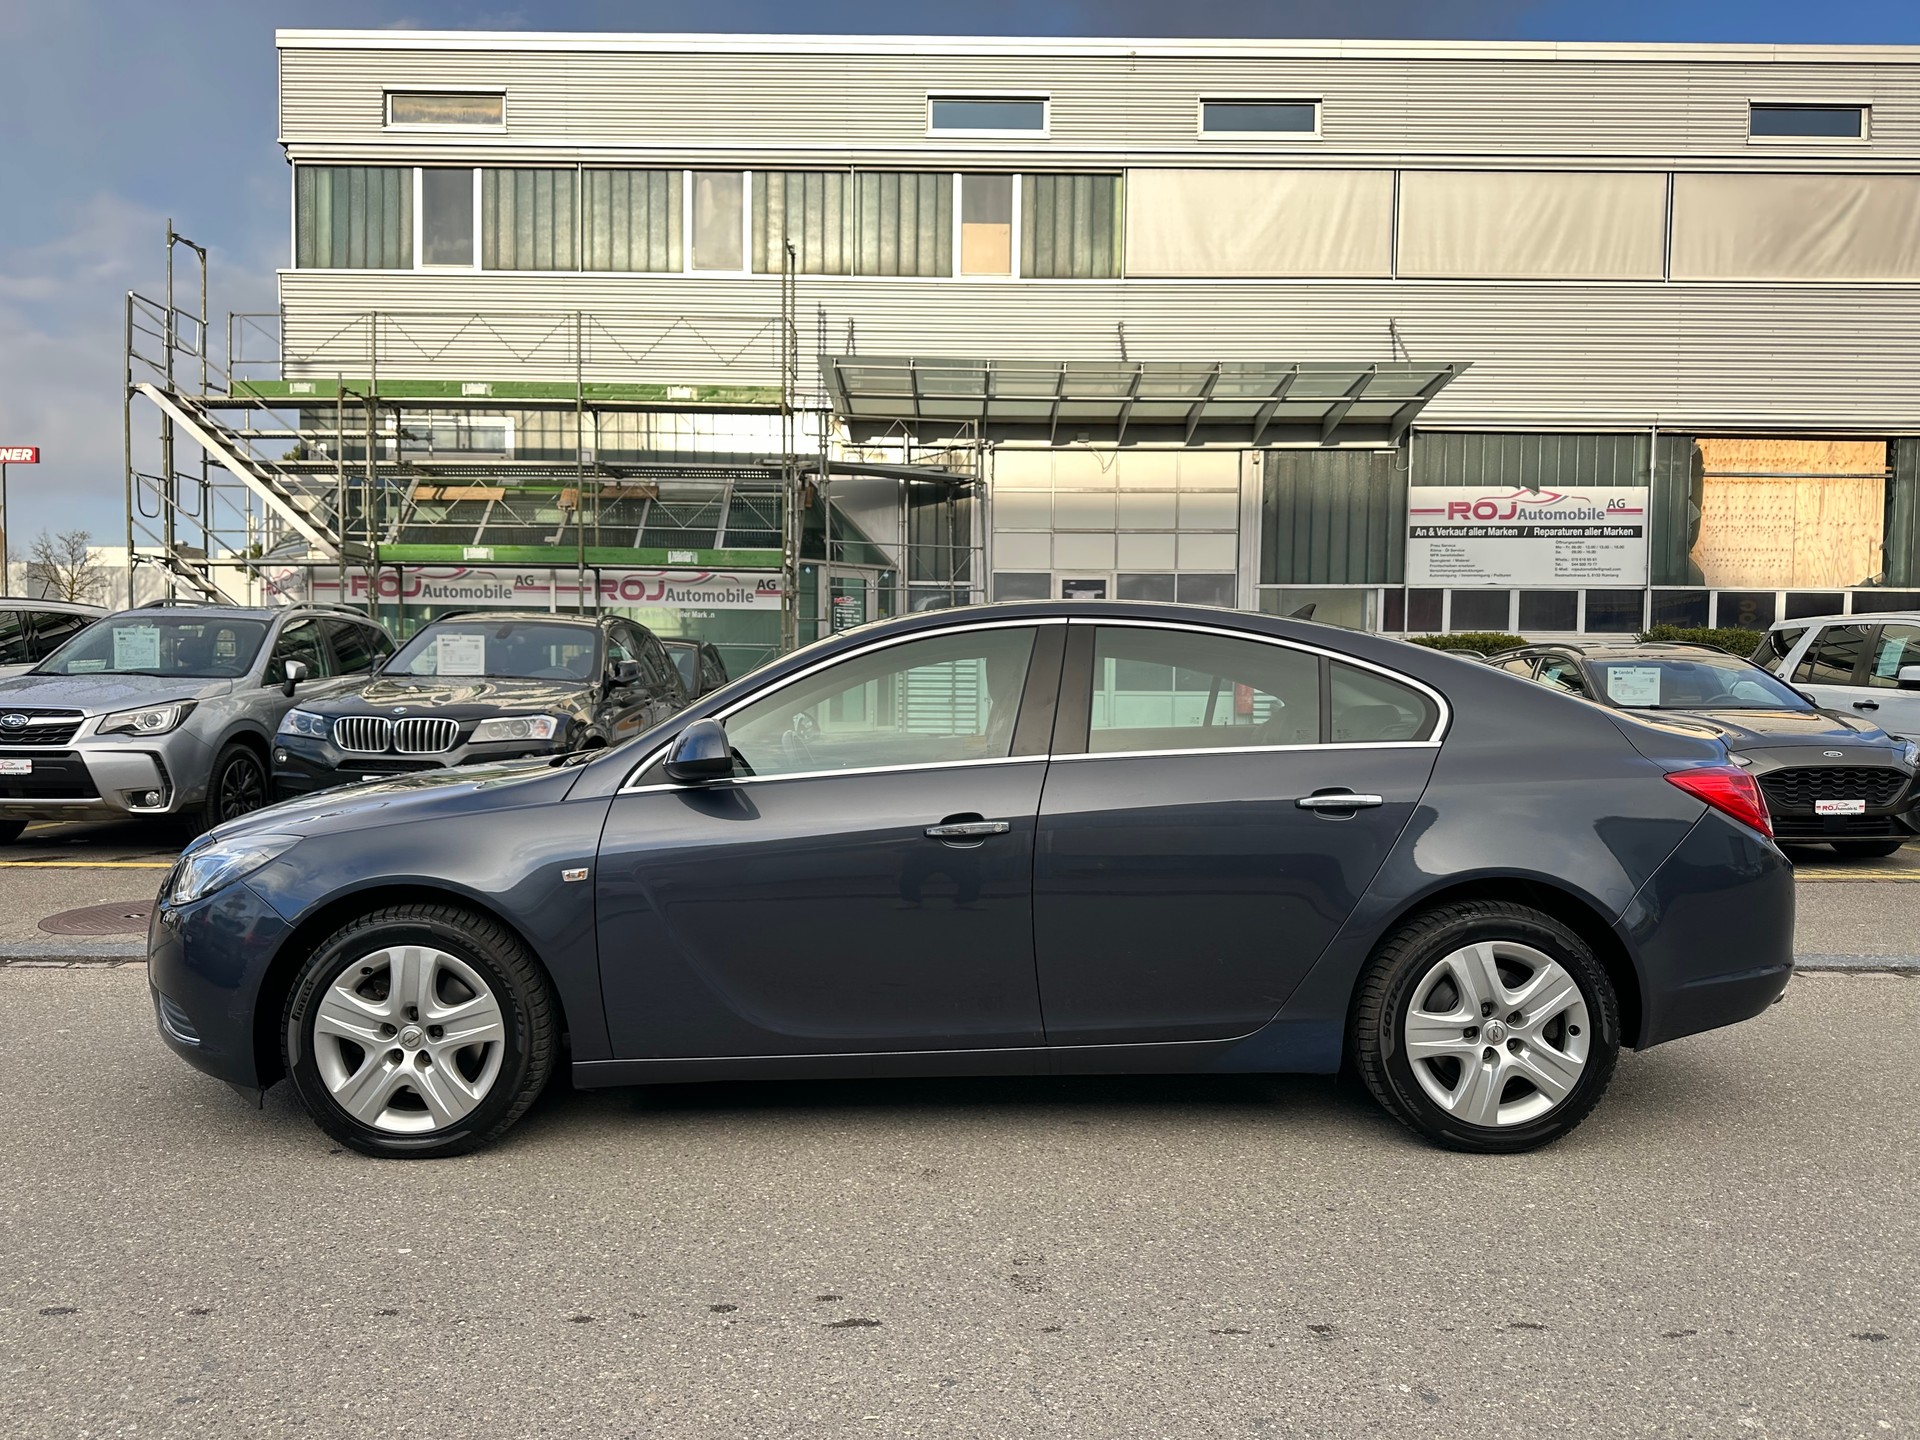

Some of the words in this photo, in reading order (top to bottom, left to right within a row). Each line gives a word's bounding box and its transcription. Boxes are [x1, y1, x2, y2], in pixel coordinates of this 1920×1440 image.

[0, 449, 33, 460] NER
[1447, 501, 1517, 520] ROJ
[1517, 508, 1605, 521] Automobile
[1607, 499, 1626, 509] AG
[1415, 528, 1427, 537] An
[1428, 528, 1435, 537] &
[1436, 528, 1467, 537] Verkauf
[1468, 528, 1486, 537] aller
[1487, 528, 1518, 537] Marken
[1533, 528, 1583, 538] Reparaturen
[1584, 528, 1602, 537] aller
[1603, 529, 1634, 537] Marken
[351, 575, 421, 597] ROJ
[422, 583, 512, 599] Automobile
[514, 575, 534, 586] AG
[600, 579, 664, 601] ROJ
[665, 588, 754, 603] Automobile
[756, 579, 776, 590] AG
[292, 979, 314, 1021] PIRELLI
